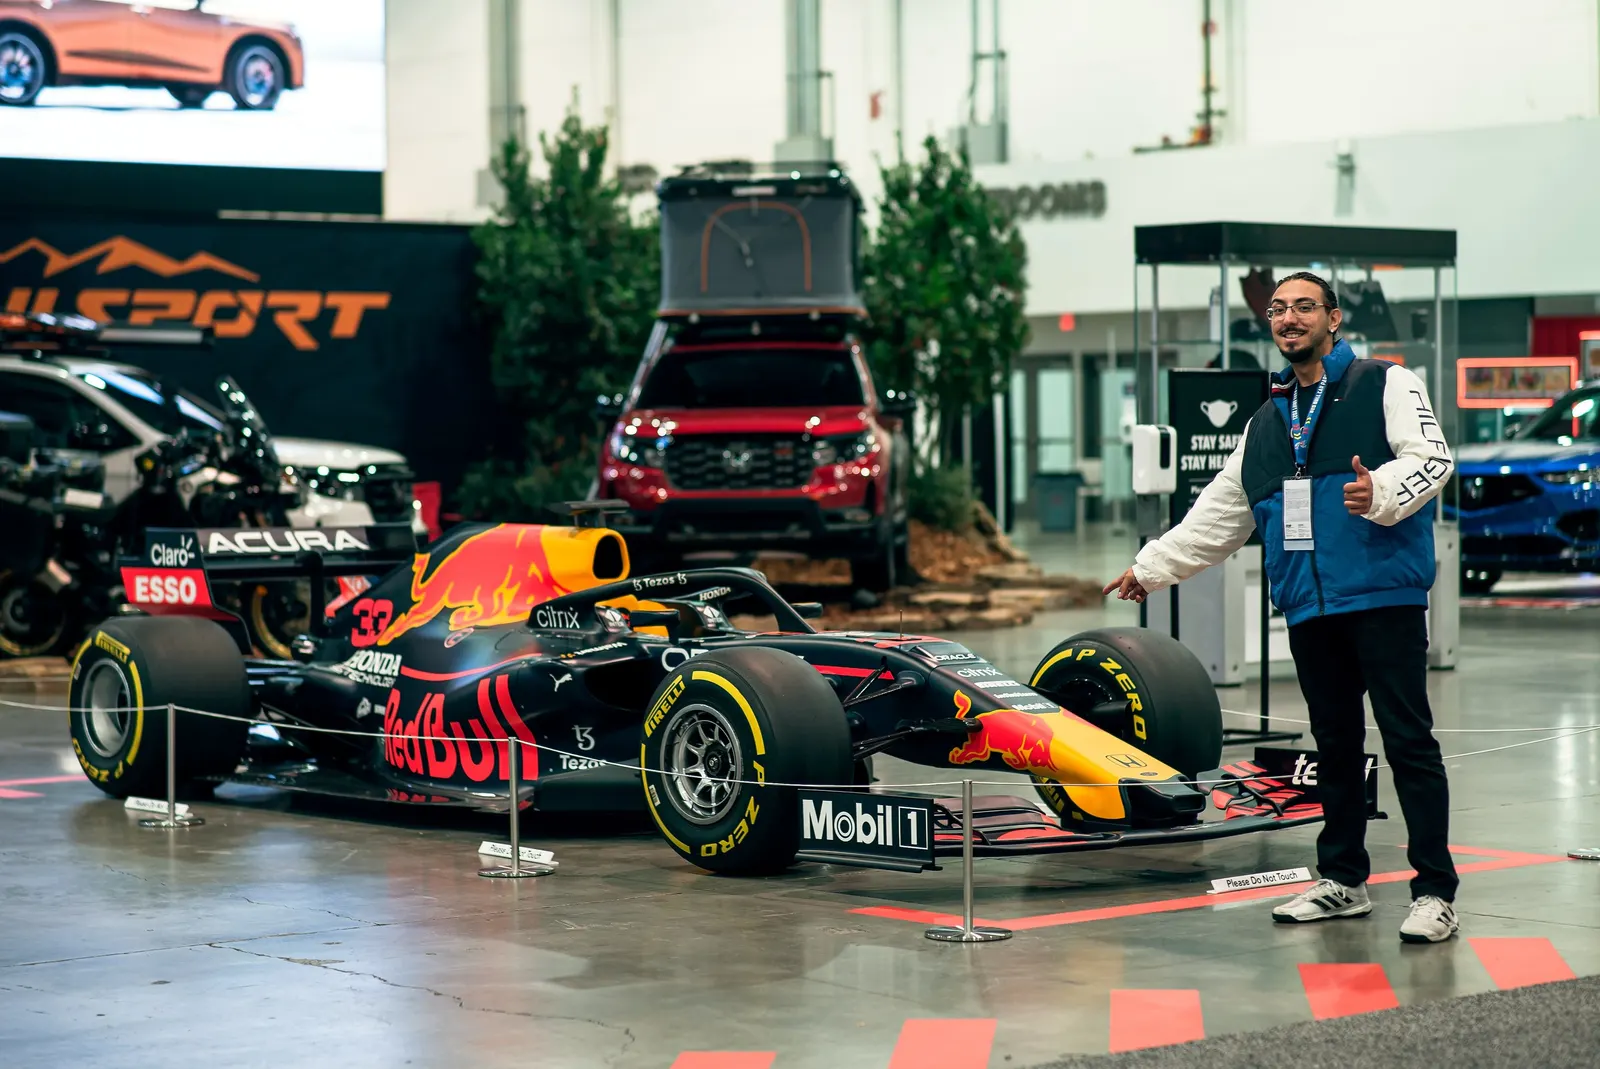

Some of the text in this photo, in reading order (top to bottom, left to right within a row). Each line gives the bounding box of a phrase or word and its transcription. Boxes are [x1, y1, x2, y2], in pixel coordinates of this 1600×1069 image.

[1190, 434, 1217, 451] STAY
[1180, 454, 1207, 471] STAY
[150, 535, 194, 567] Claro
[208, 529, 371, 554] ACURA
[134, 575, 197, 605] ESSO
[643, 576, 675, 588] Tezos
[699, 586, 731, 601] HONDA
[350, 597, 394, 648] 33
[536, 606, 580, 630] citrix
[345, 649, 402, 677] HONDA
[935, 652, 977, 662] ORACLE
[956, 666, 1003, 678] citrix
[644, 674, 687, 738] PIRELLI
[1075, 648, 1147, 741] P ZERO
[700, 760, 765, 857] P ZERO
[802, 799, 919, 846] Mobil 1
[1226, 870, 1298, 888] Please Do Not Touch
